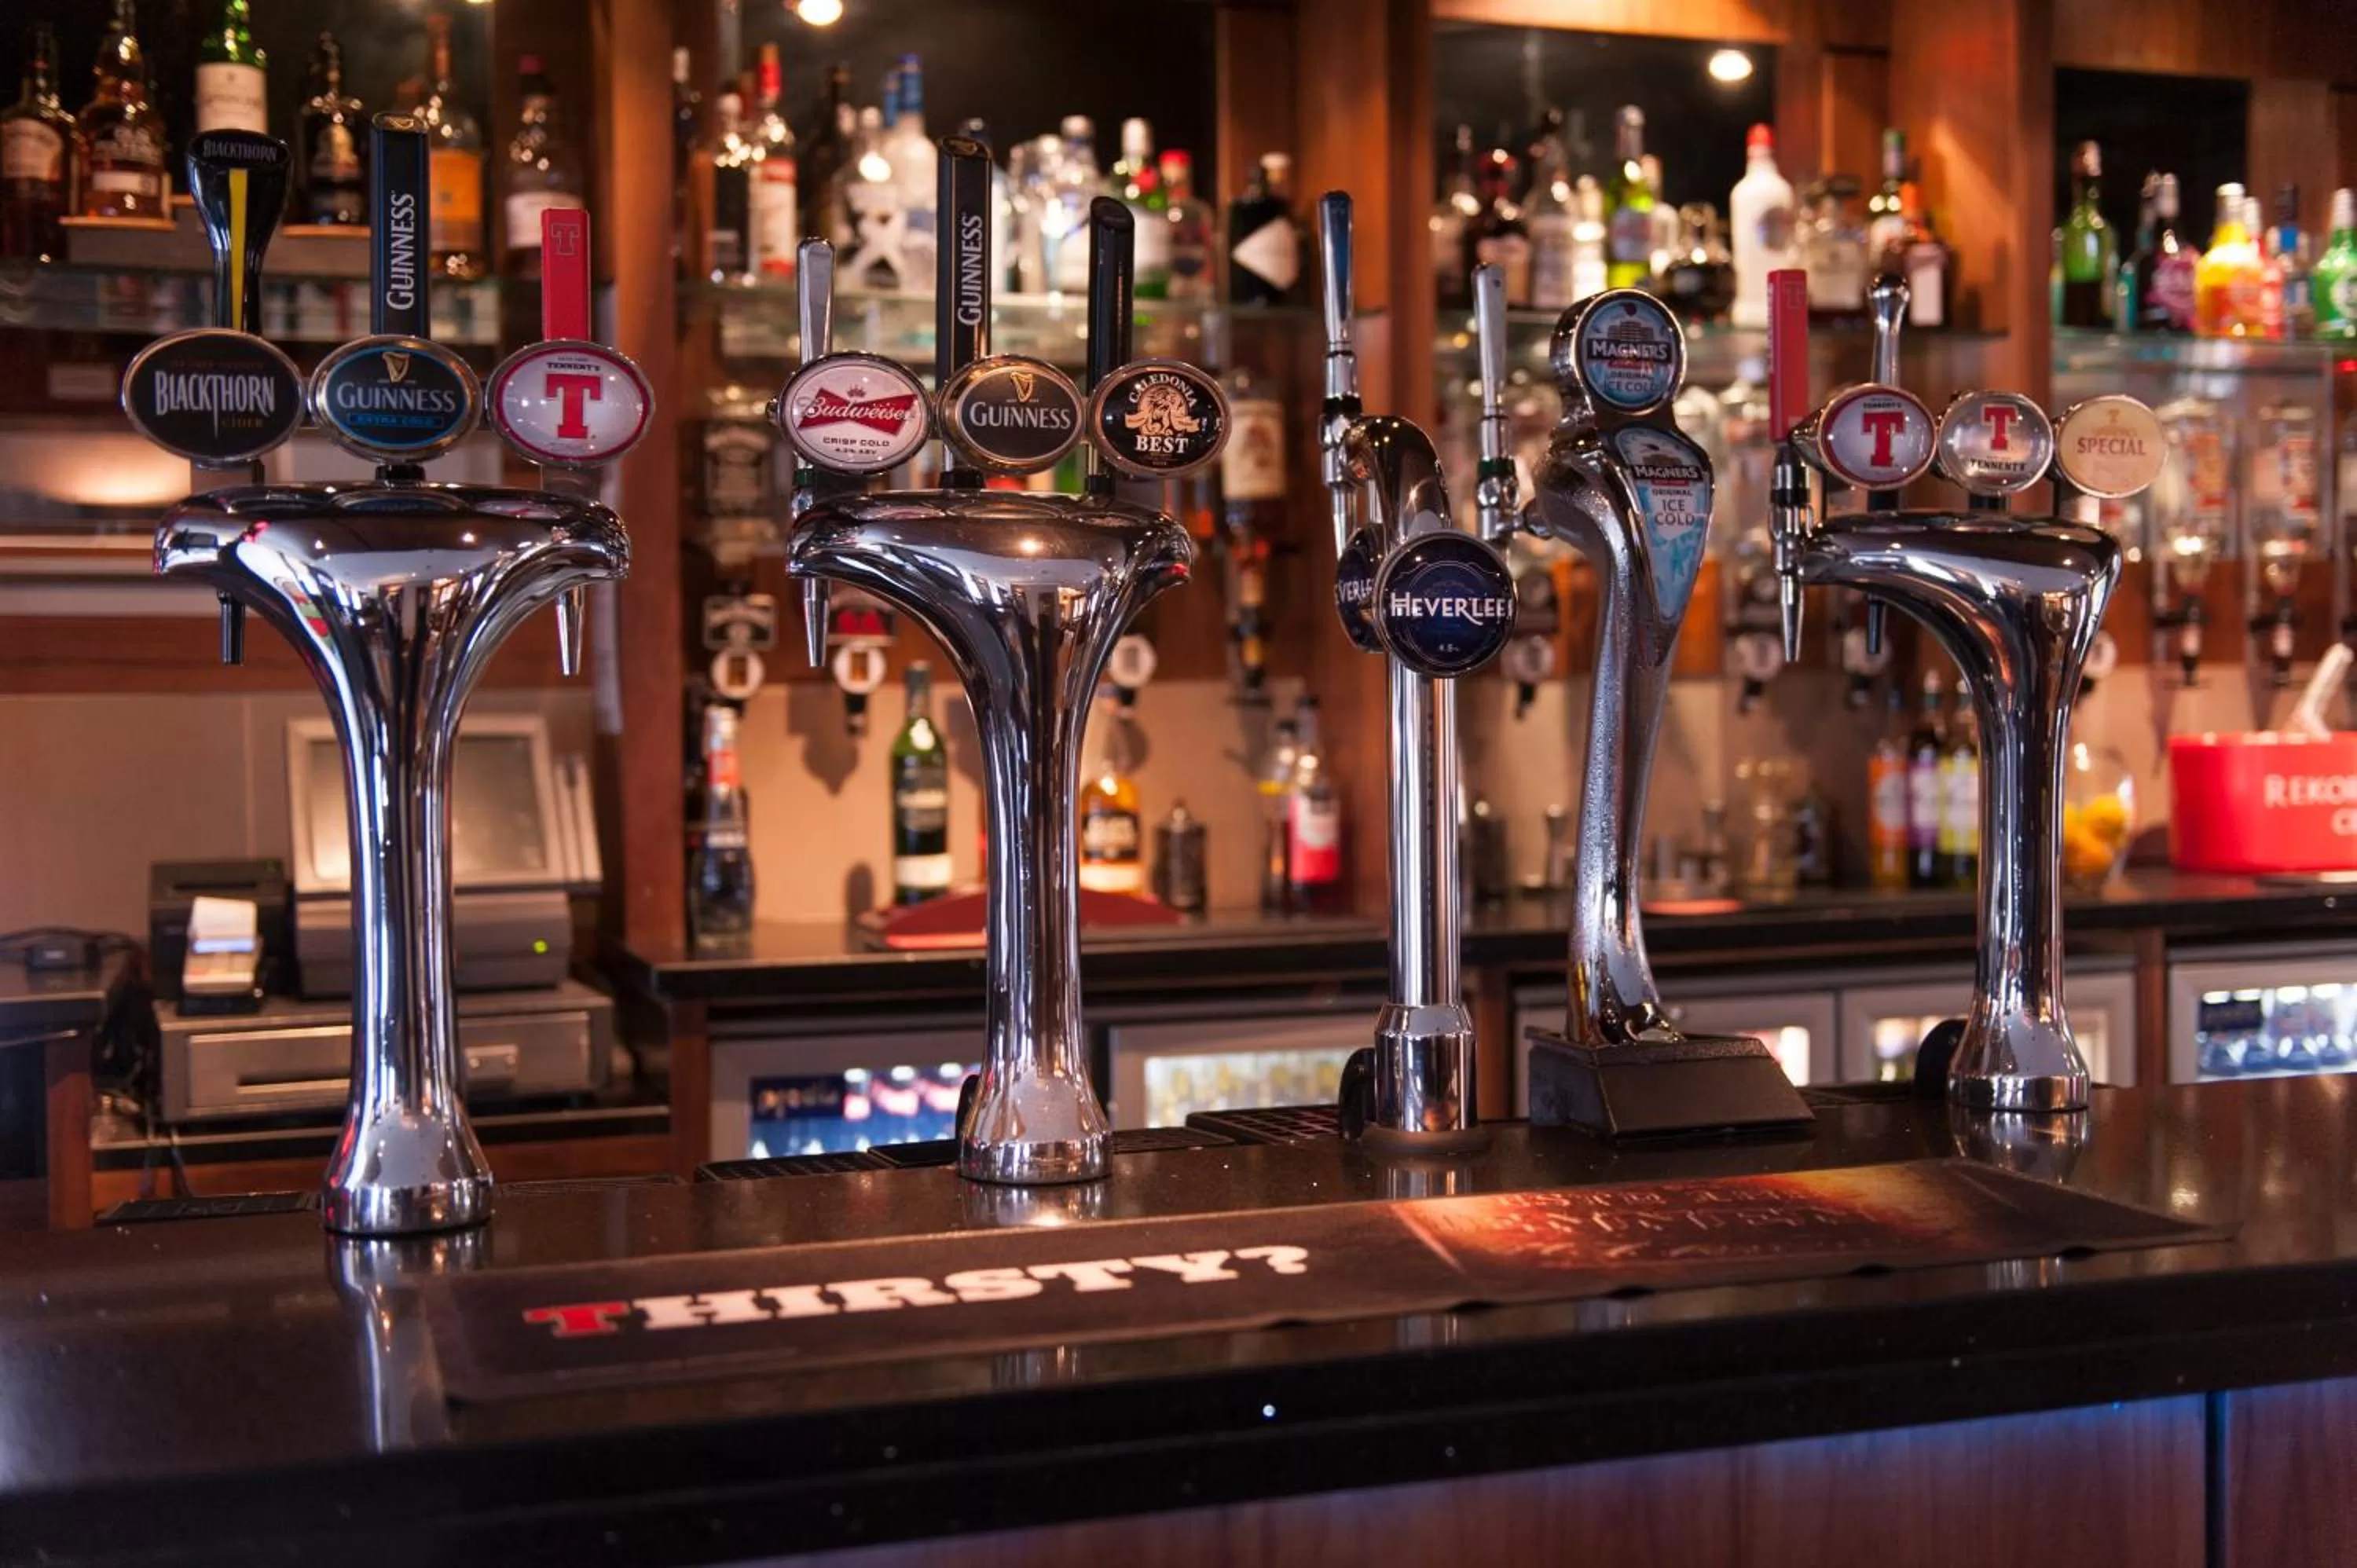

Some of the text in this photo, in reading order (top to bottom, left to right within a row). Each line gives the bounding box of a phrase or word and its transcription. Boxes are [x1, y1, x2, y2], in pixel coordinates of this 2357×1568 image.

[387, 193, 415, 310] GUINNESS
[957, 214, 982, 326] GUINNESS
[1592, 339, 1667, 360] MAGNERS
[155, 370, 275, 440] BLACKTHORN
[336, 382, 456, 412] GUINNESS
[546, 374, 601, 438] T
[1128, 374, 1198, 408] CALEDONIA
[797, 396, 915, 421] Budweiser
[970, 401, 1071, 430] GUINNESS
[823, 436, 890, 448] CRISP COLD
[1863, 412, 1904, 467] T
[1984, 405, 2018, 450] T
[1135, 435, 1189, 454] BEST
[2077, 438, 2146, 456] SPECIAL
[1655, 512, 1695, 526] COLD
[1662, 499, 1685, 511] ICE
[522, 1245, 1309, 1339] THIRSTY?
